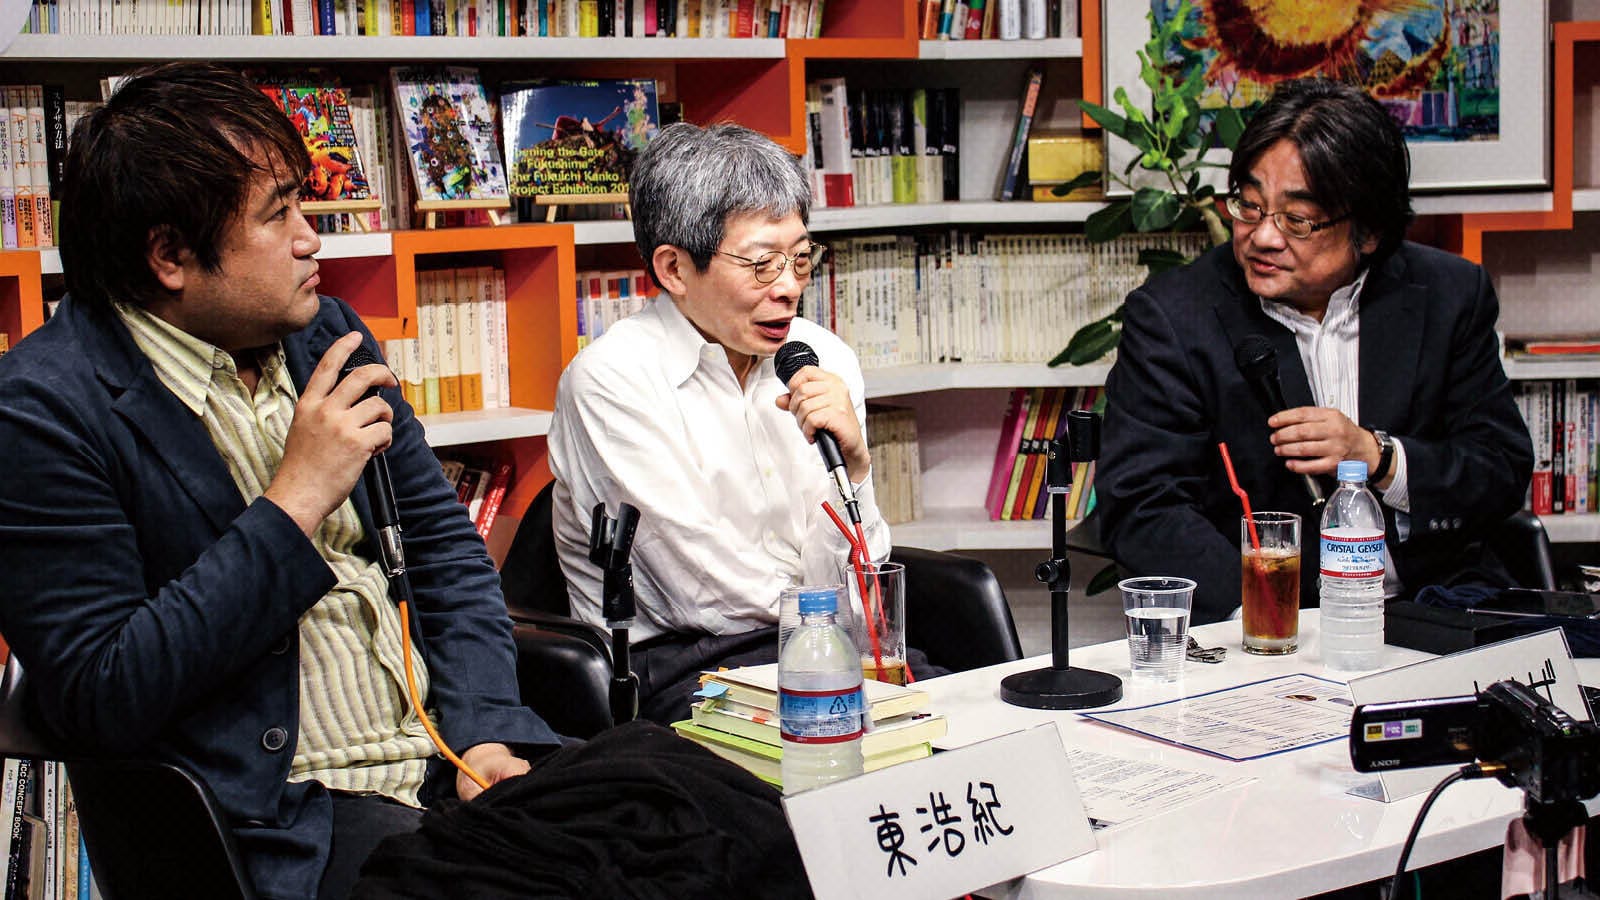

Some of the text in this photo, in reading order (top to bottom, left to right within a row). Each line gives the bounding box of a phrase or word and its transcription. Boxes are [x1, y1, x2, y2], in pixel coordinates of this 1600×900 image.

[514, 146, 605, 158] pening the Gate
[533, 171, 581, 182] Fukuichi
[584, 171, 620, 181] Kanko
[509, 183, 550, 196] Project
[553, 183, 608, 194] Exhibition
[1326, 542, 1385, 554] CRYSTAL GEYSER
[1369, 758, 1401, 769] SONY
[11, 763, 28, 839] ICC CONCEPT BOOK
[868, 782, 1014, 878] 東浩紀
